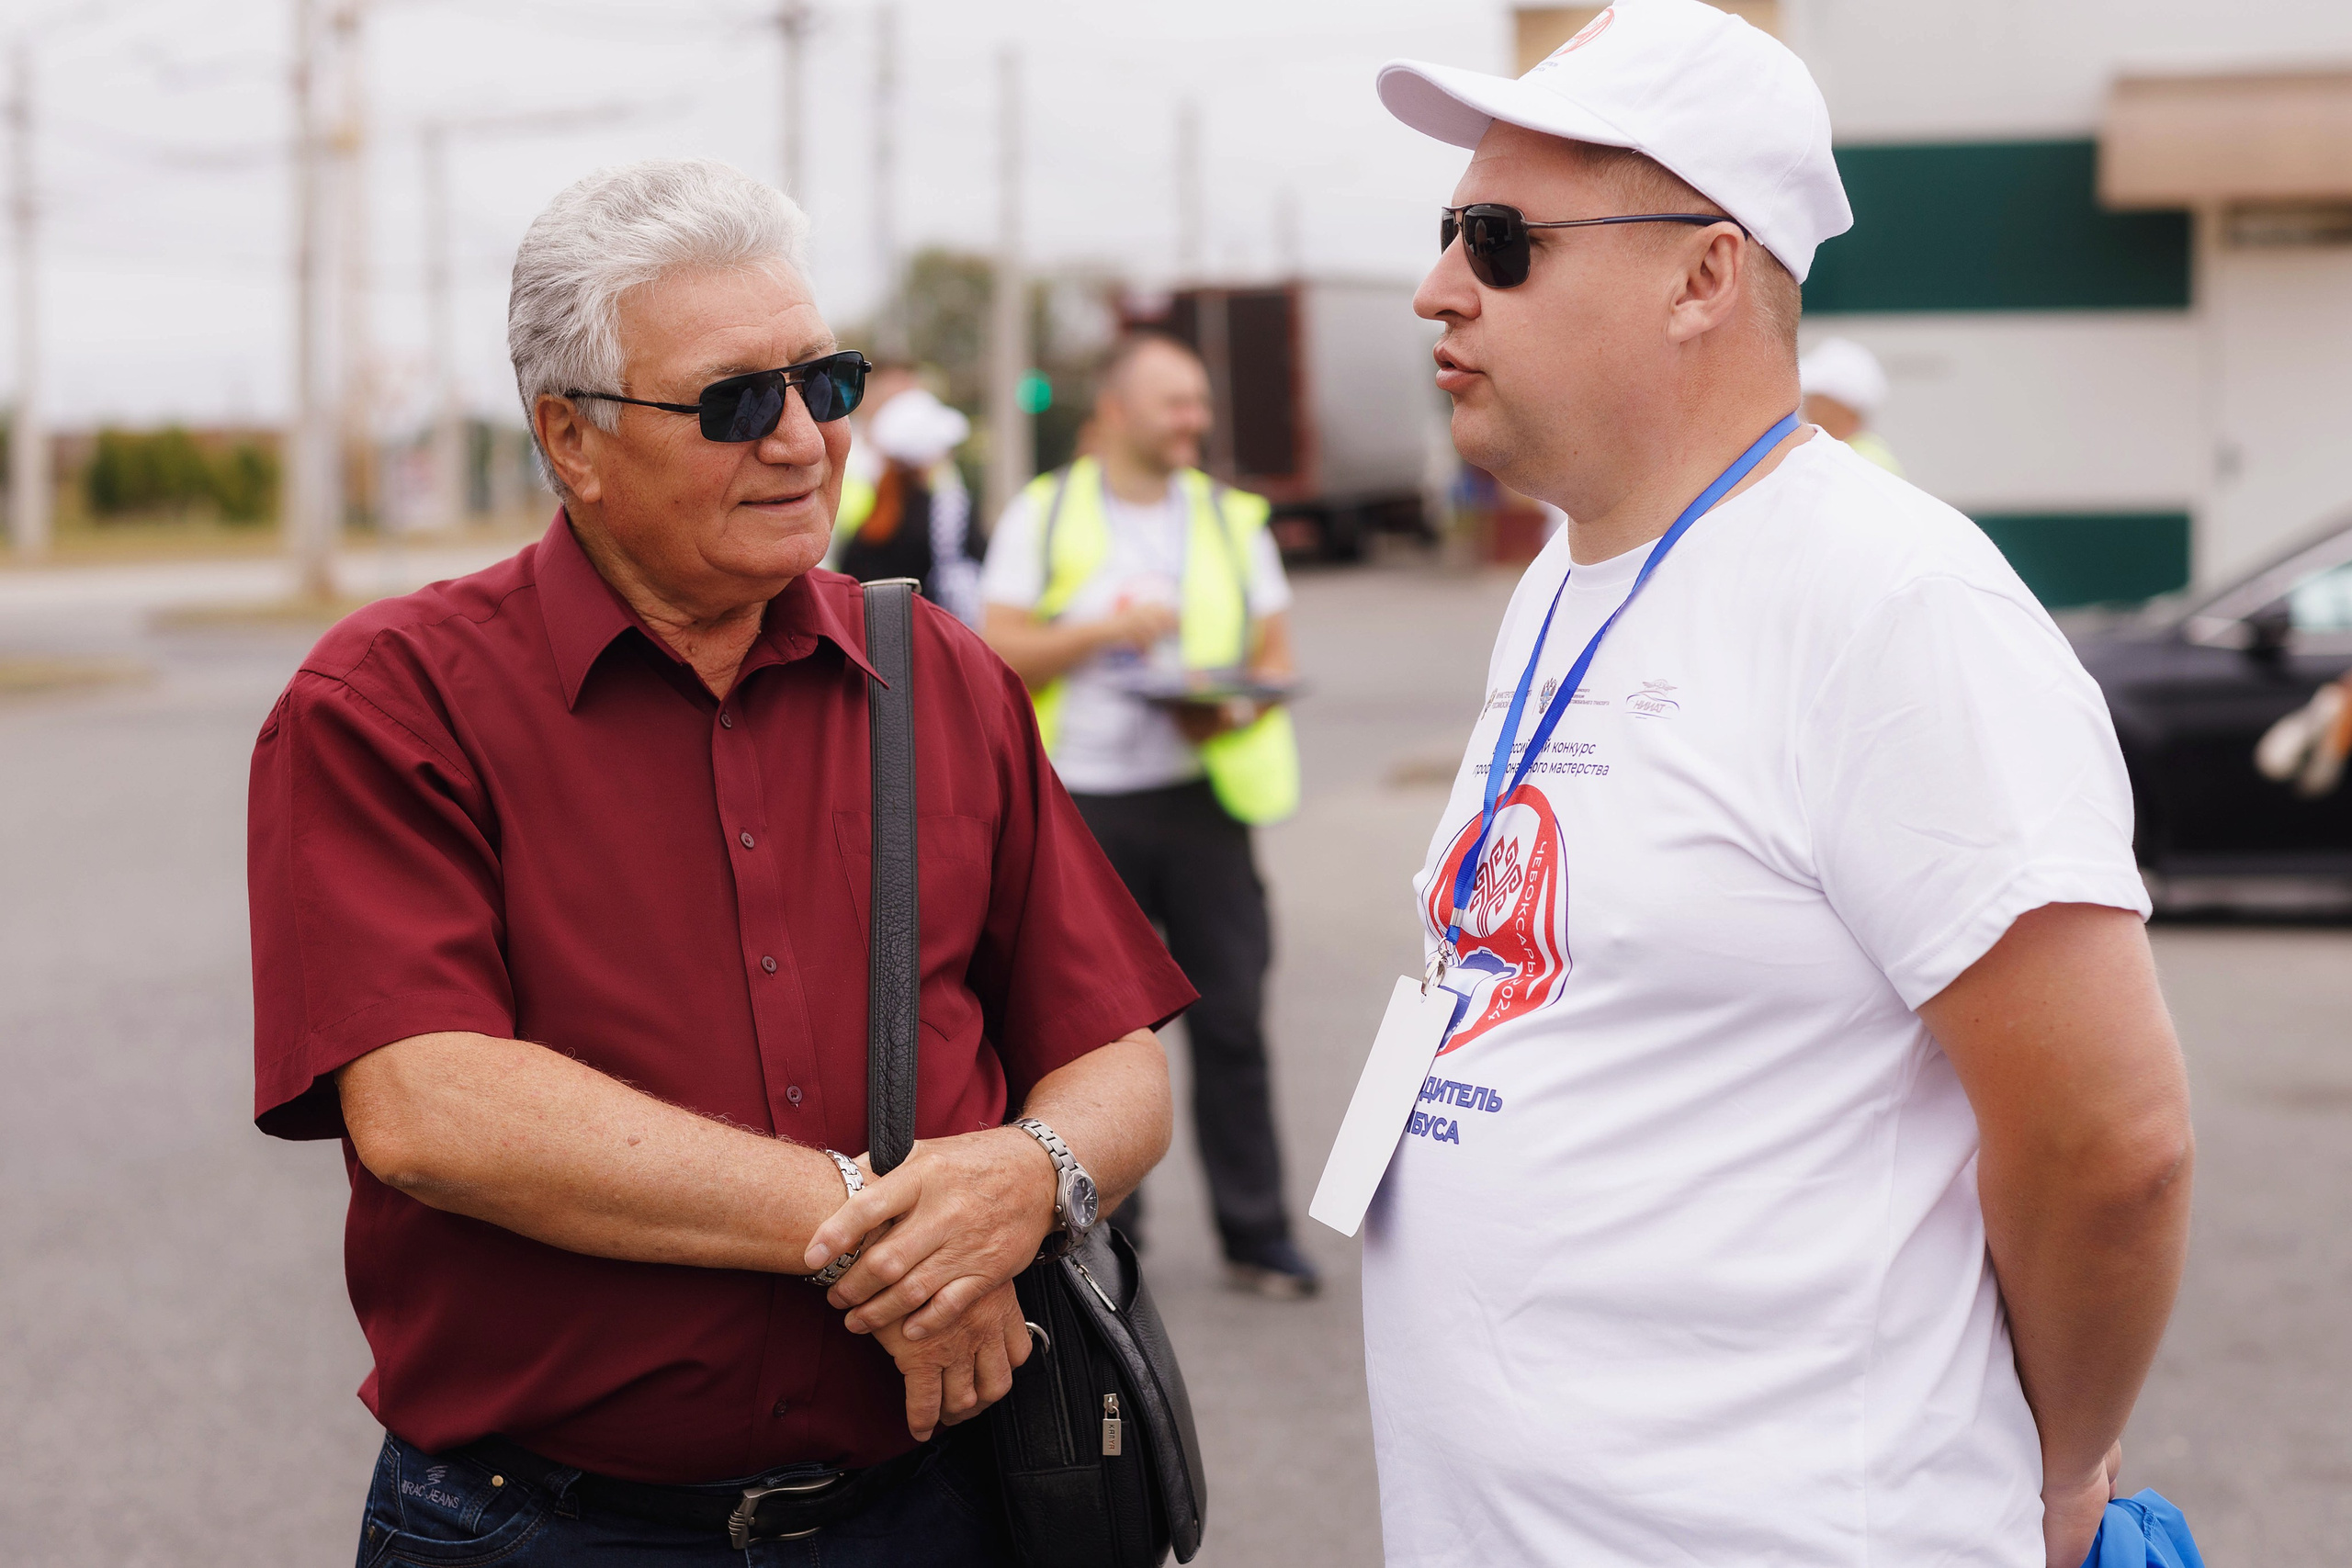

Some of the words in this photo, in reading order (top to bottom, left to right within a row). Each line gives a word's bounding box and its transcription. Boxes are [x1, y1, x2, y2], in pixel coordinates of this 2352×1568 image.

[1551, 741, 1596, 757] конкурс
[1548, 762, 1610, 777] мастерства
[1515, 840, 1547, 977] ЧЕБОКСАРЫ
[1419, 1076, 1503, 1112] ДИТЕЛЬ
[425, 1488, 459, 1508] JEANS
